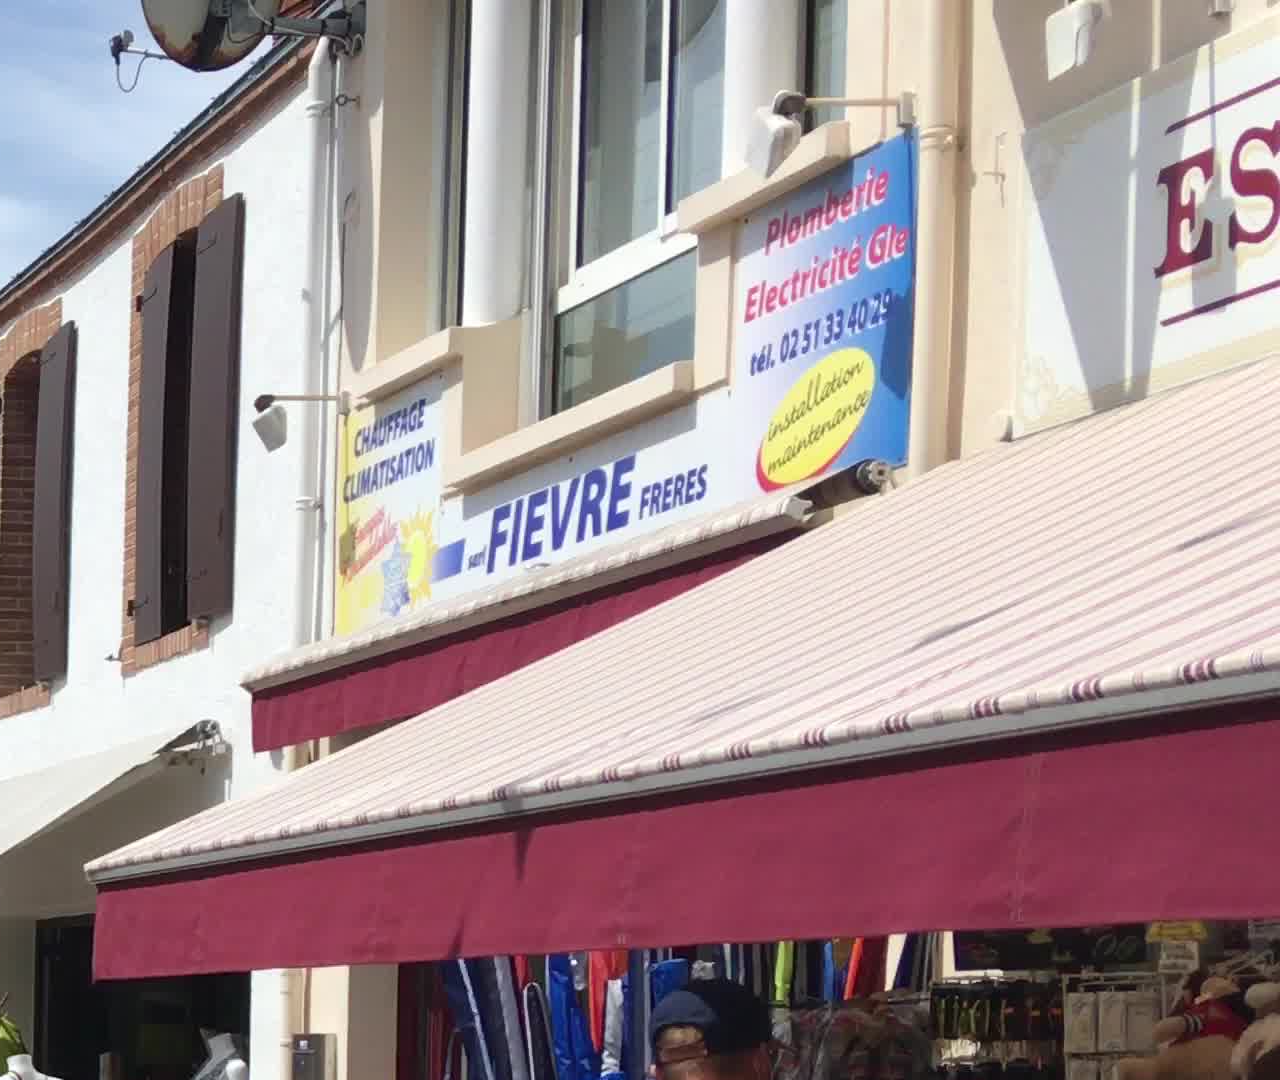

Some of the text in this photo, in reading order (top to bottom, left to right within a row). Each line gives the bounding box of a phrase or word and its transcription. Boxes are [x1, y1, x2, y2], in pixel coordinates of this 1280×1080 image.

[764, 167, 890, 256] Plomberie
[743, 223, 910, 323] Electricité Gle
[749, 343, 776, 376] tél.
[780, 328, 799, 363] 02
[801, 318, 820, 354] 51
[823, 309, 844, 345] 33
[847, 297, 868, 334] 40
[354, 398, 427, 458] CHAUFFAGE
[767, 390, 871, 476] maintenance
[768, 360, 865, 442] installation
[343, 437, 436, 504] CLIMATISATION
[487, 454, 637, 575] FIEVRE
[638, 463, 709, 521] FRERES
